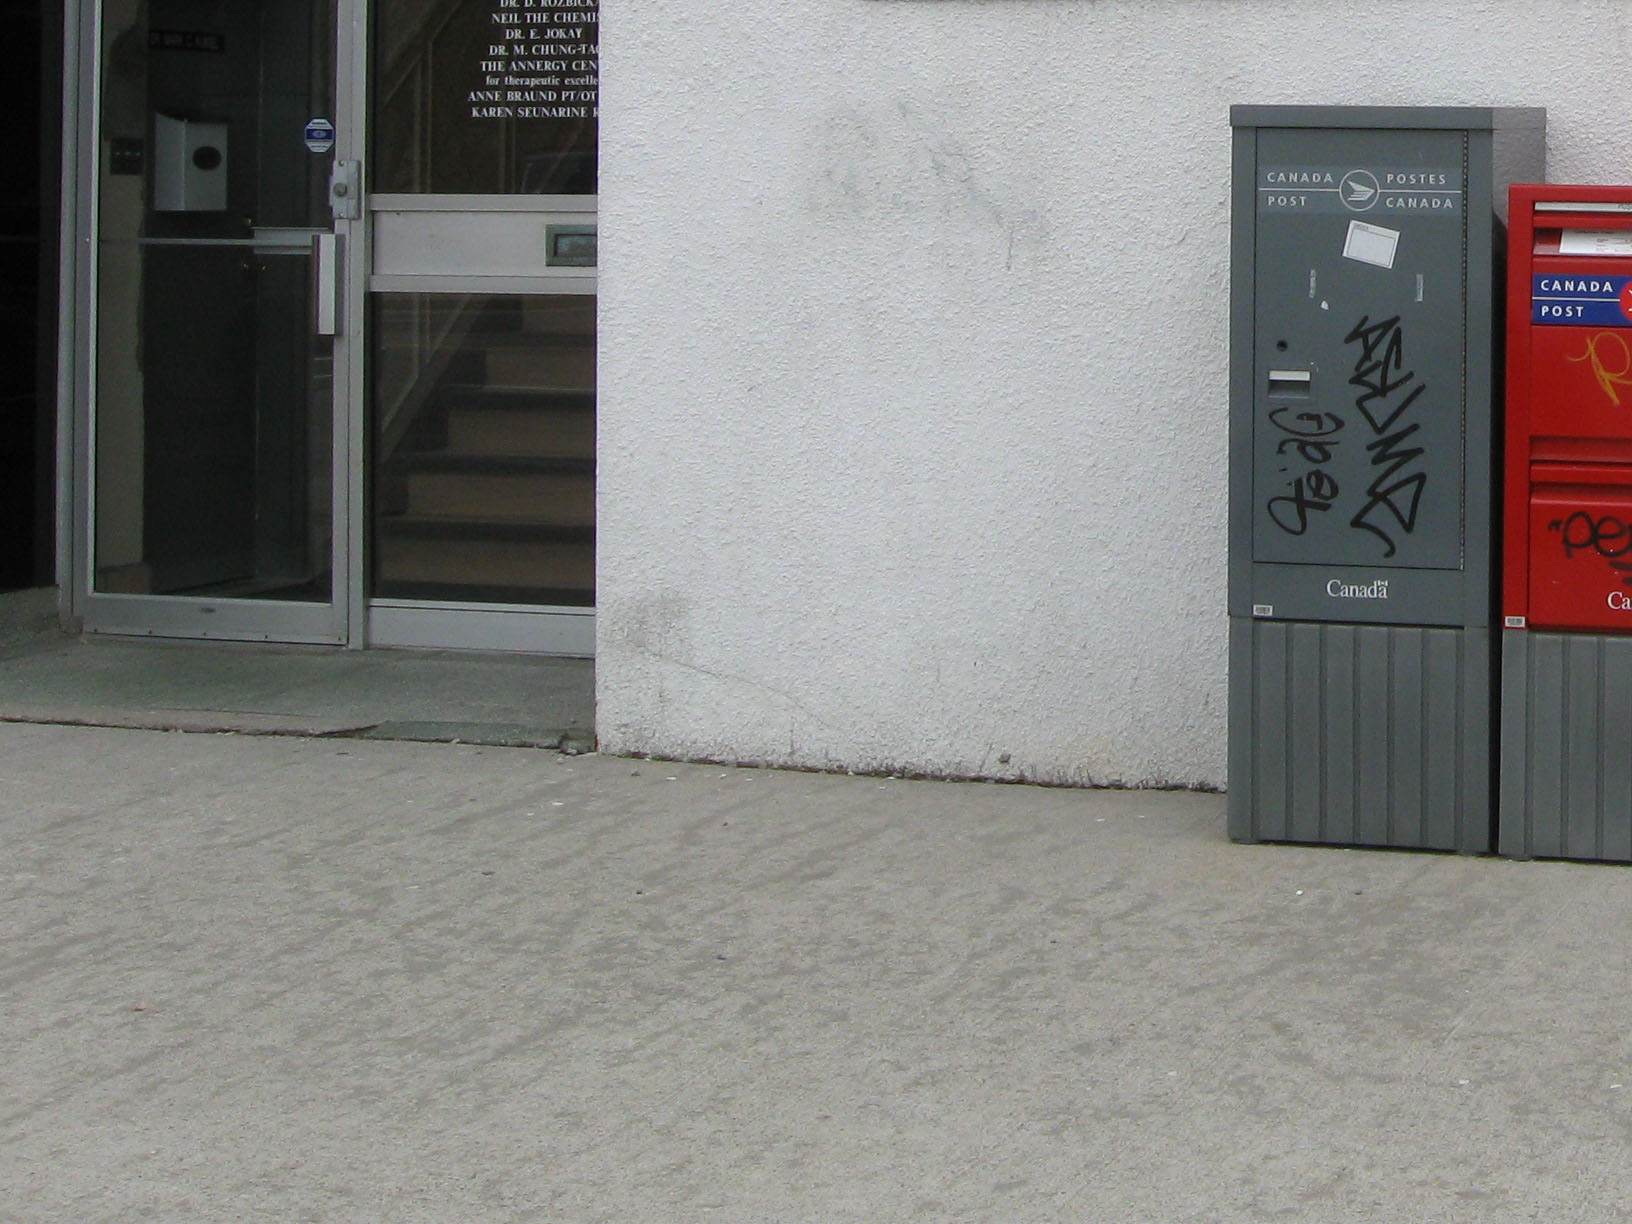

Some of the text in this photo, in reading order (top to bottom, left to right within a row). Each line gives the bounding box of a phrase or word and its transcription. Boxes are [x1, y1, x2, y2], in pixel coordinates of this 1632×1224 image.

[492, 12, 521, 24] NEIL
[525, 12, 549, 24] THE
[505, 28, 583, 39] DR. E. JOKAY
[489, 44, 509, 56] DR.
[513, 44, 528, 56] M.
[480, 60, 505, 72] THE
[509, 60, 568, 72] ANNERGY
[486, 75, 499, 87] for
[505, 75, 560, 87] therapeutic
[468, 91, 597, 102] ANNE BRAUND PT/OT
[472, 106, 513, 118] KAREN
[517, 106, 588, 118] SEUNARINE
[1266, 172, 1334, 183] CANADA
[1386, 173, 1447, 185] POSTES
[1267, 195, 1308, 207] POST
[1385, 197, 1454, 209] CANADA
[1540, 279, 1614, 293] CANADA
[1541, 305, 1585, 317] POST
[1326, 579, 1388, 599] Canada
